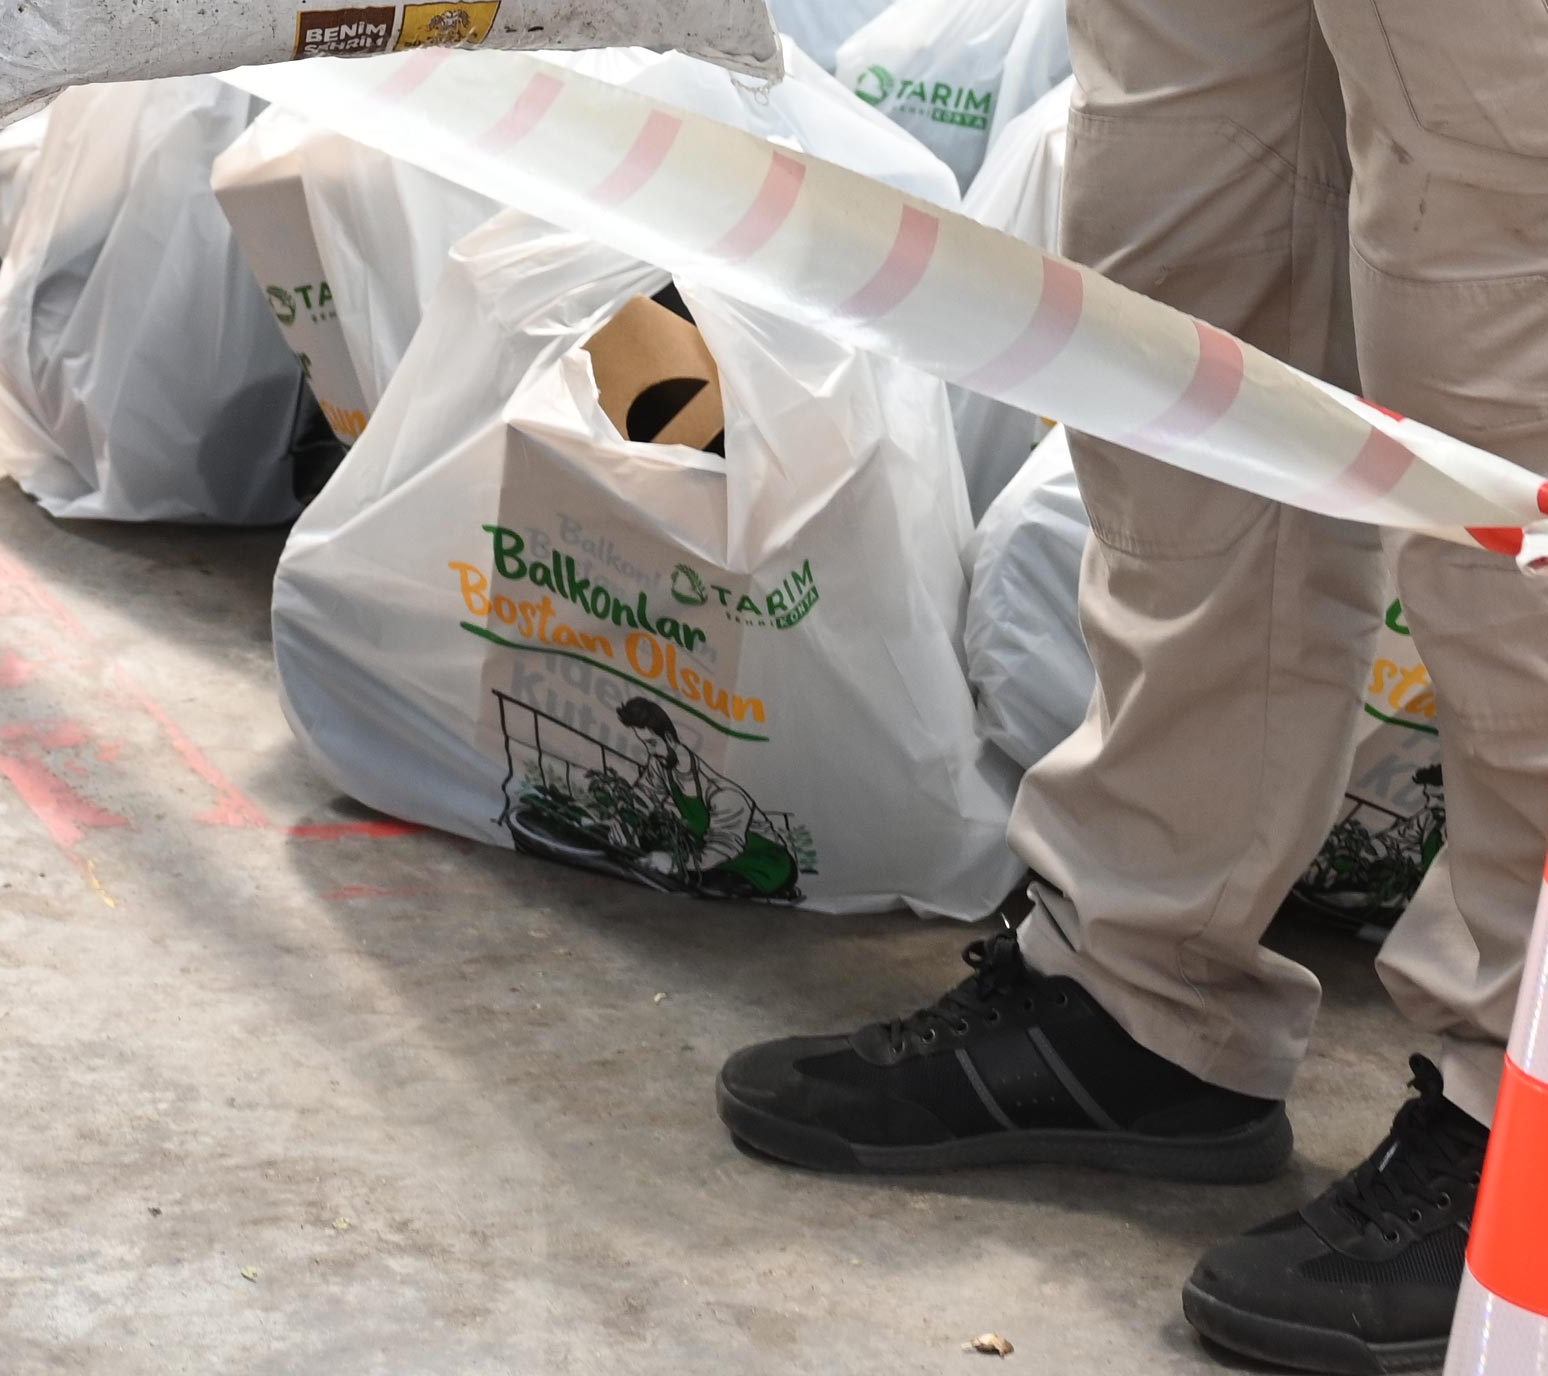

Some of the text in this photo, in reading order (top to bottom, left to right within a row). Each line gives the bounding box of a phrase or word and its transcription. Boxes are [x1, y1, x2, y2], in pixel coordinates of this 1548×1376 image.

[305, 20, 388, 44] BENİM
[896, 79, 993, 115] TARIM
[481, 524, 814, 653] Balkonlar TARIM
[449, 561, 767, 723] Bostan Olsun
